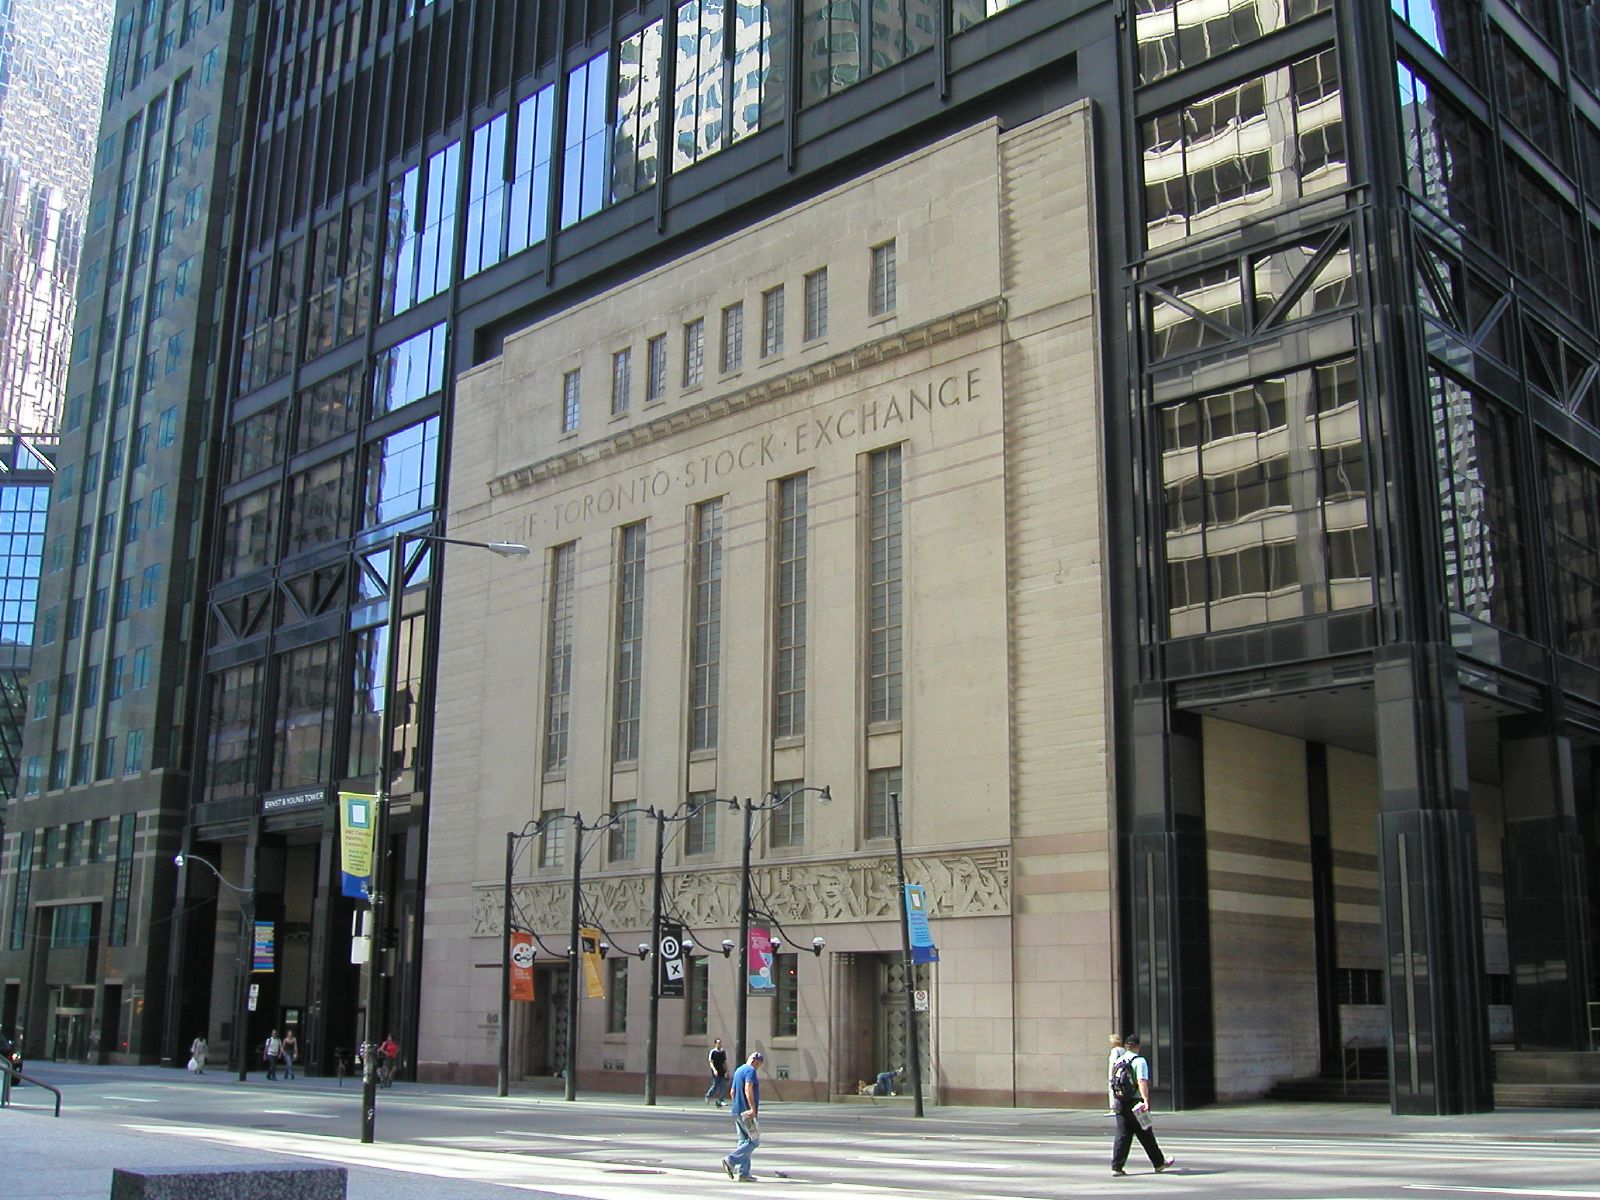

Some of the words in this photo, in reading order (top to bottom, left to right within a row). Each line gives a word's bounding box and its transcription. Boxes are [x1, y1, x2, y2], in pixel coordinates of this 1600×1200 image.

[554, 470, 671, 530] TORONTO
[684, 433, 776, 488] STOCK
[795, 366, 982, 455] EXCHANGE
[264, 799, 282, 809] ERNST
[286, 795, 304, 805] YOUNG
[304, 791, 324, 802] TOWER
[671, 964, 680, 975] X
